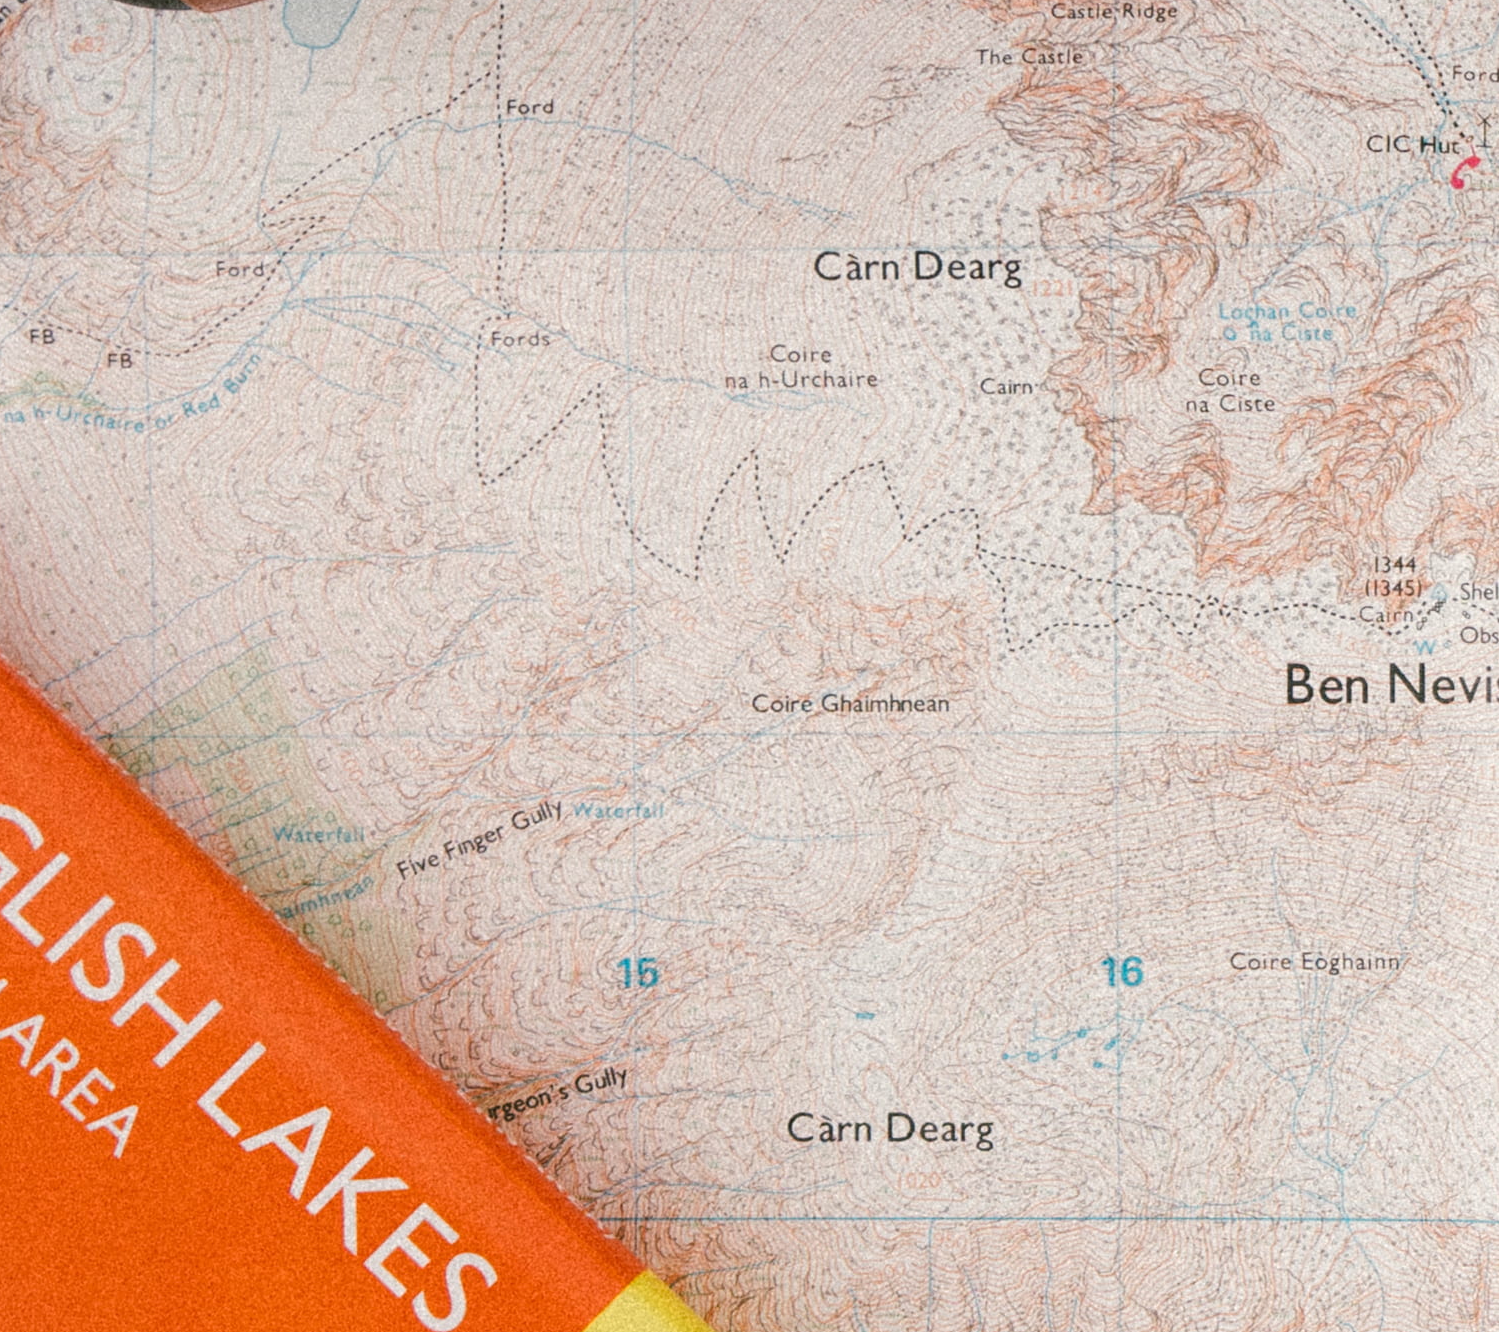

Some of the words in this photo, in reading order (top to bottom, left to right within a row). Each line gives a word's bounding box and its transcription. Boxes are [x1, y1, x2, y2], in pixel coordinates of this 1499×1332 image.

[1365, 134, 1412, 155] CIC
[1420, 134, 1460, 155] Hut
[812, 250, 901, 283] Càrn
[912, 250, 1024, 289] Dearg
[1285, 664, 1371, 708] Ben
[1099, 956, 1146, 987] 16
[785, 1111, 874, 1145] Càrn
[884, 1111, 996, 1153] Dearg
